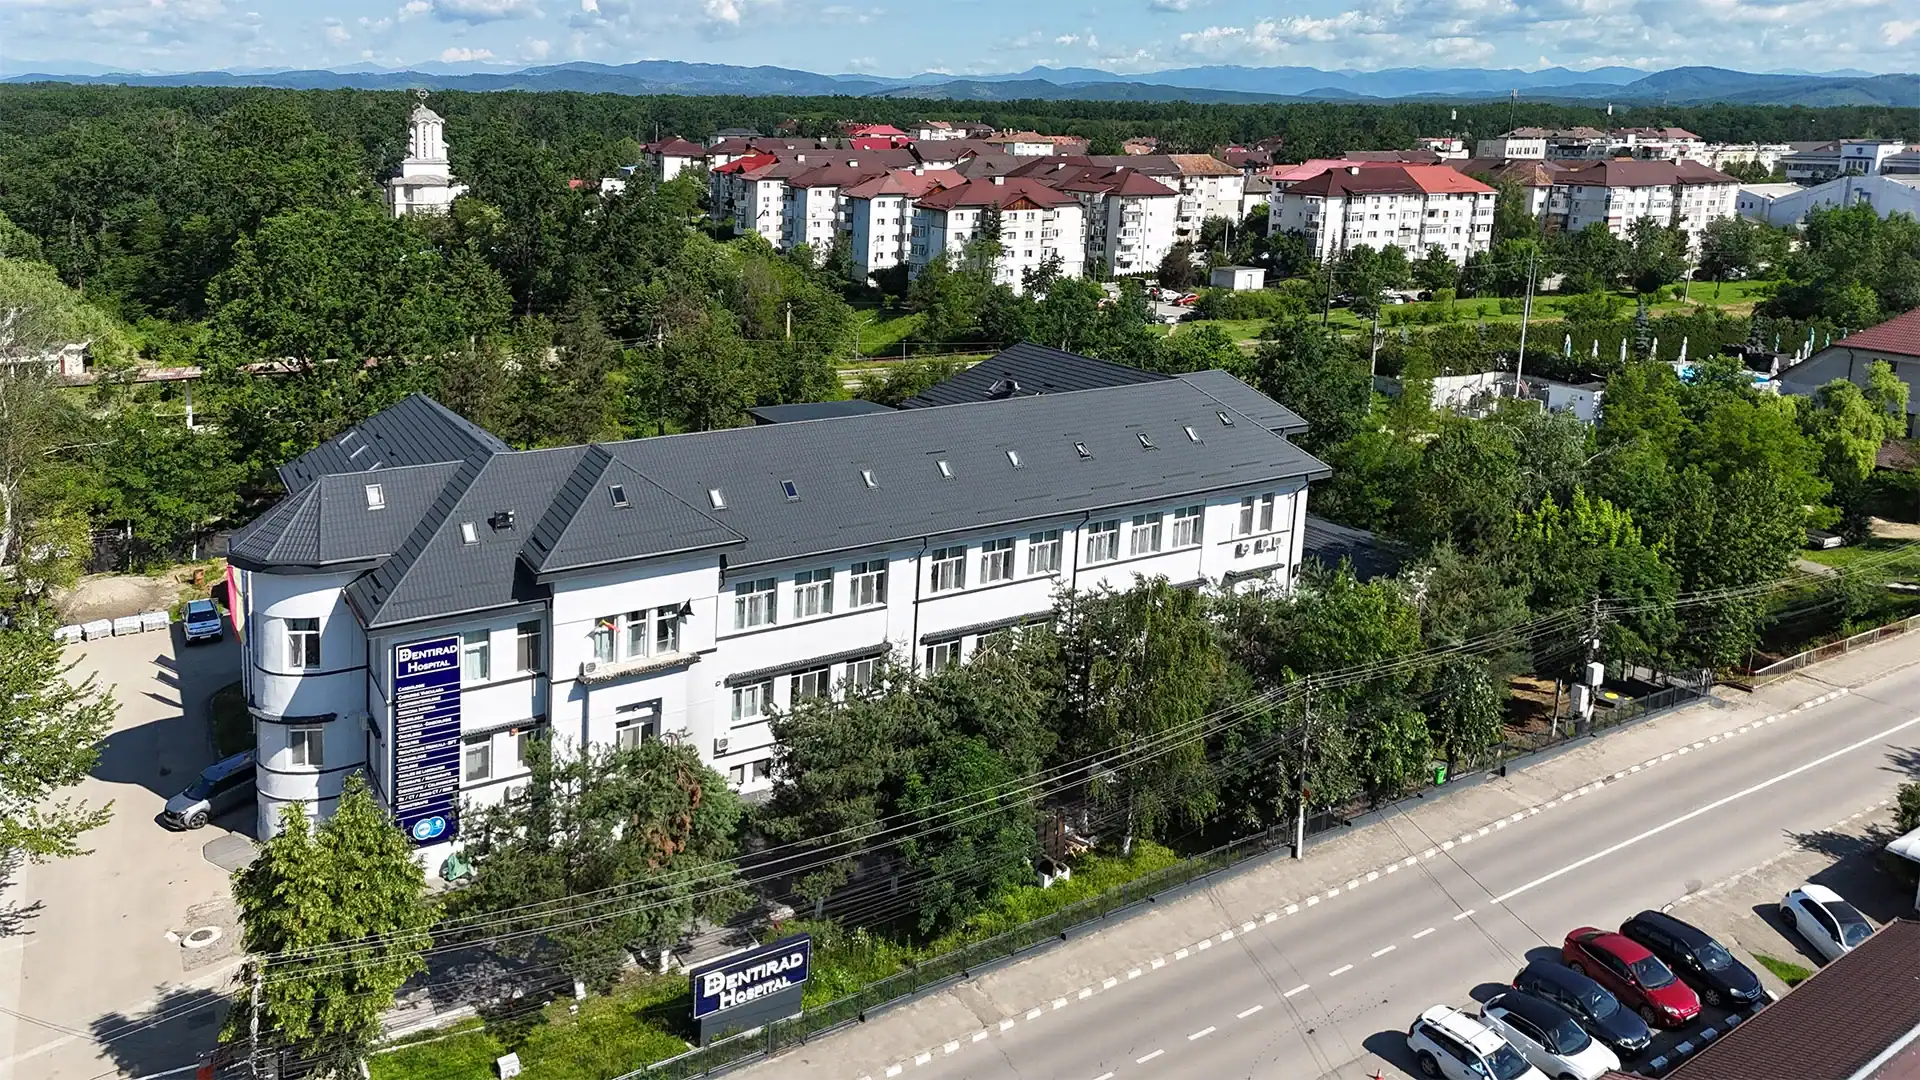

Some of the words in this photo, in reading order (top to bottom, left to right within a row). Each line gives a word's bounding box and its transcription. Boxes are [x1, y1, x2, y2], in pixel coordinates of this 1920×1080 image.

[399, 645, 458, 662] DENTIRAD
[408, 660, 450, 672] HOSPITAL
[703, 953, 803, 998] DENTIRAD
[719, 976, 792, 1010] HOSPITAL
